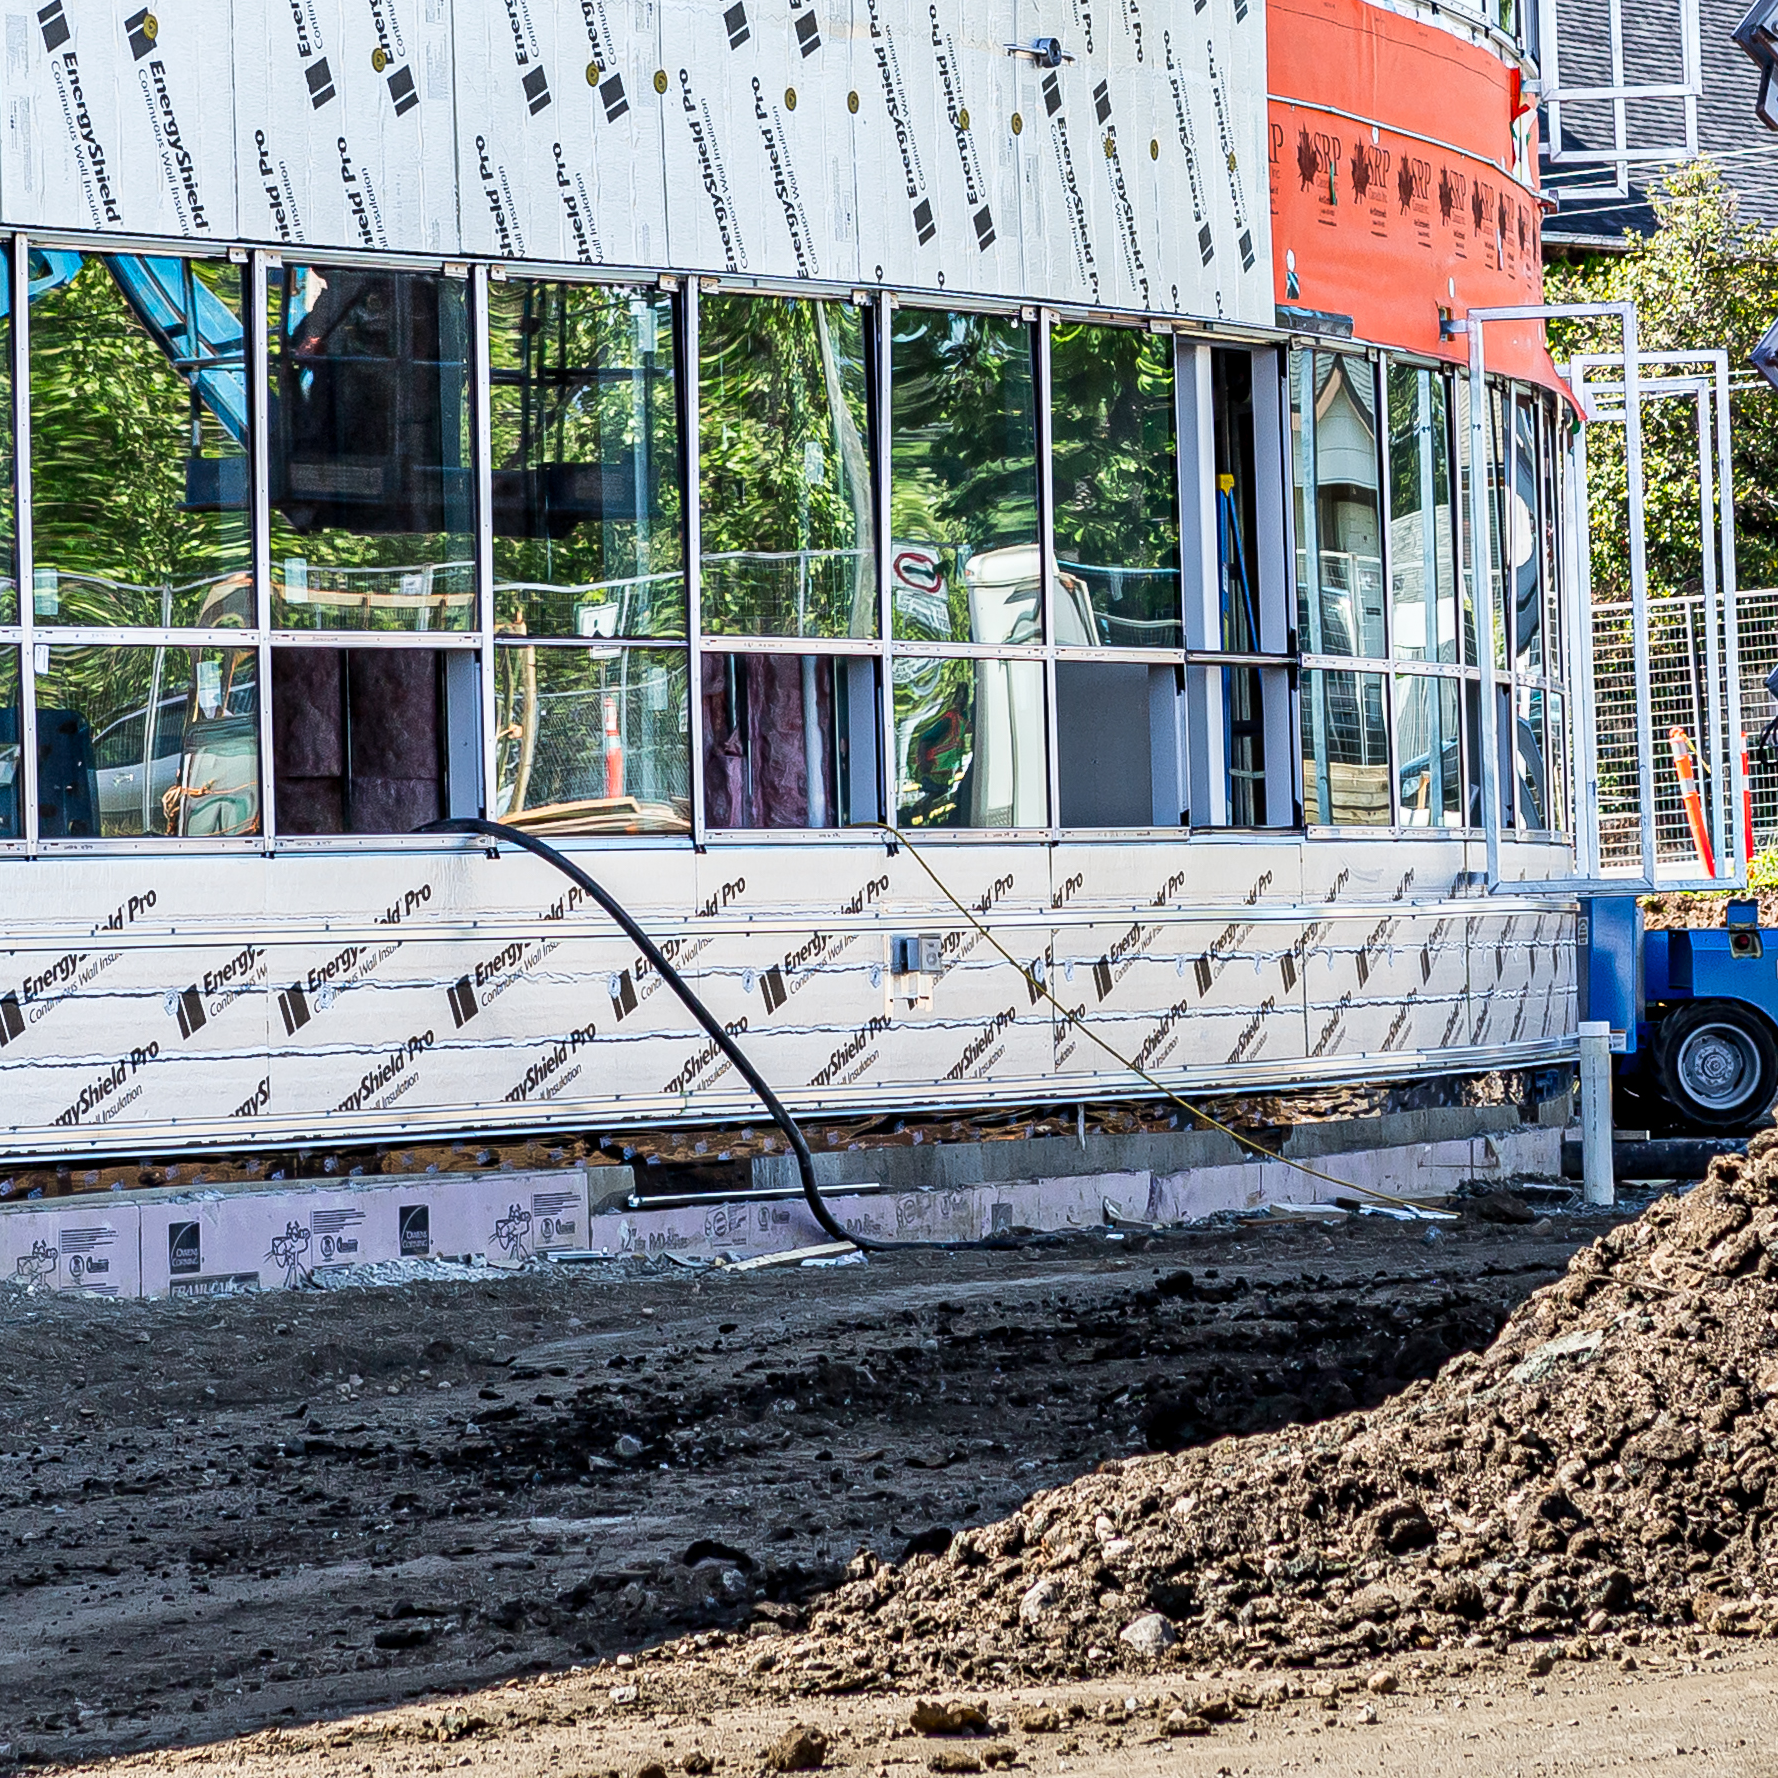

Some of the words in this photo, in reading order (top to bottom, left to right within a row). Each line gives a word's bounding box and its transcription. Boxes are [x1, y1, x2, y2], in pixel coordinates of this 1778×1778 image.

[886, 24, 901, 87] Insulation
[1132, 22, 1143, 63] Pro
[1164, 30, 1175, 70] Pro
[679, 69, 696, 113] Pro
[898, 89, 909, 116] Wall
[700, 97, 721, 162] Insulation
[874, 46, 917, 199] EnergyShield
[475, 135, 495, 182] Pro
[905, 118, 926, 191] Continuous
[1170, 79, 1202, 222] EnergyShield
[1314, 132, 1342, 176] SRP
[1368, 146, 1390, 189] SRP
[690, 120, 738, 273] EnergyShield
[1058, 117, 1094, 264] EnergyShield
[1411, 158, 1431, 200] SRP
[725, 194, 748, 269] Continuous
[125, 888, 157, 923] Pro
[991, 874, 1014, 900] Pro
[994, 1006, 1016, 1033] Pro
[407, 1028, 434, 1062] Pro
[99, 1084, 144, 1124] Insulation
[381, 1071, 419, 1108] Insulation
